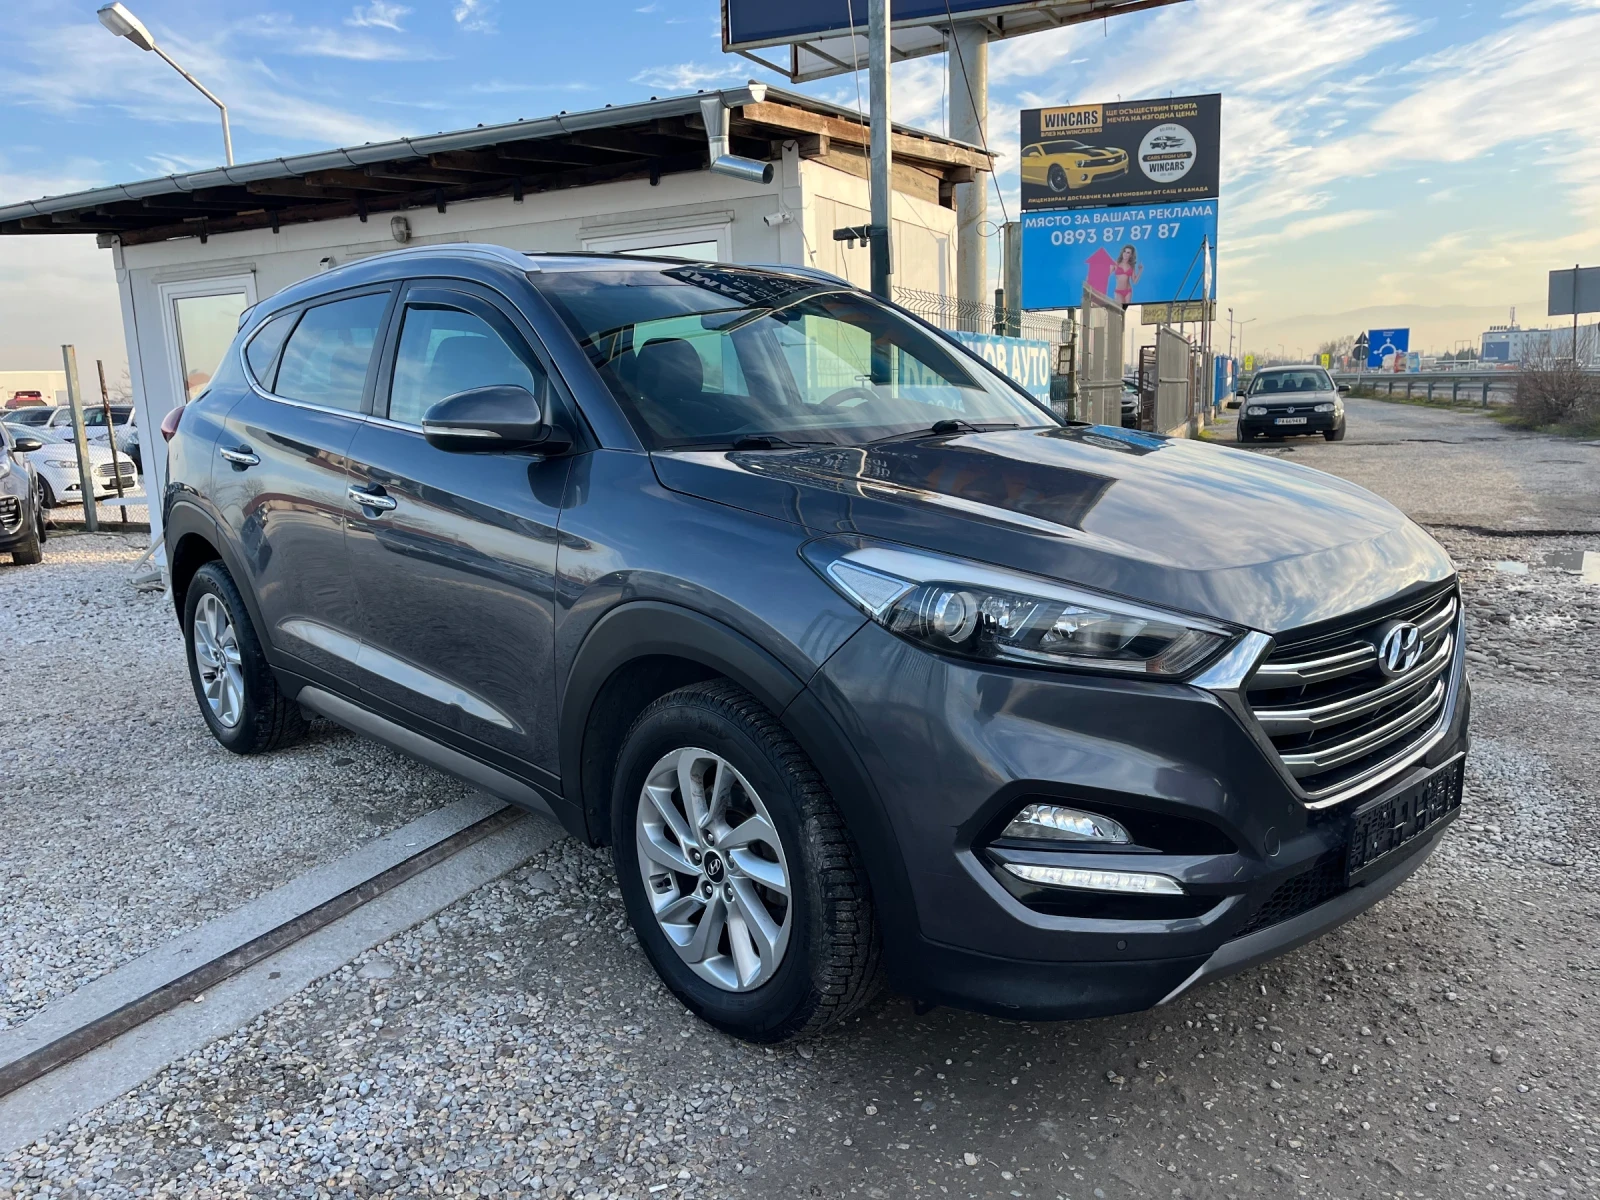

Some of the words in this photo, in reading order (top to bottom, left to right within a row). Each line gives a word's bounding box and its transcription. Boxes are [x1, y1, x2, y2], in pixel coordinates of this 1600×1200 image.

[1118, 105, 1169, 115] ОСЪЩЕСТВИМ
[1170, 102, 1198, 111] ТВОЯТА
[1142, 112, 1175, 121] ИЗГОДНА
[1175, 109, 1198, 119] ЦЕНА!
[1044, 110, 1098, 128] WINCARS
[1149, 161, 1185, 172] WINCARS
[1028, 195, 1066, 203] ЛИЦЕНЗИРАН
[1066, 193, 1102, 201] ДОСТАВЧИК
[1111, 190, 1153, 198] АВТОМОБИЛИ
[1025, 215, 1072, 228] МЯСТО
[1074, 213, 1090, 225] ЗА
[1093, 210, 1146, 224] ВАШАТА
[1149, 206, 1213, 219] РЕКЛАМА
[1051, 228, 1097, 246] 0893
[1102, 226, 1125, 242] 87
[1130, 224, 1153, 241] 87
[1158, 222, 1181, 239] 87
[1011, 346, 1049, 386] АУТО
